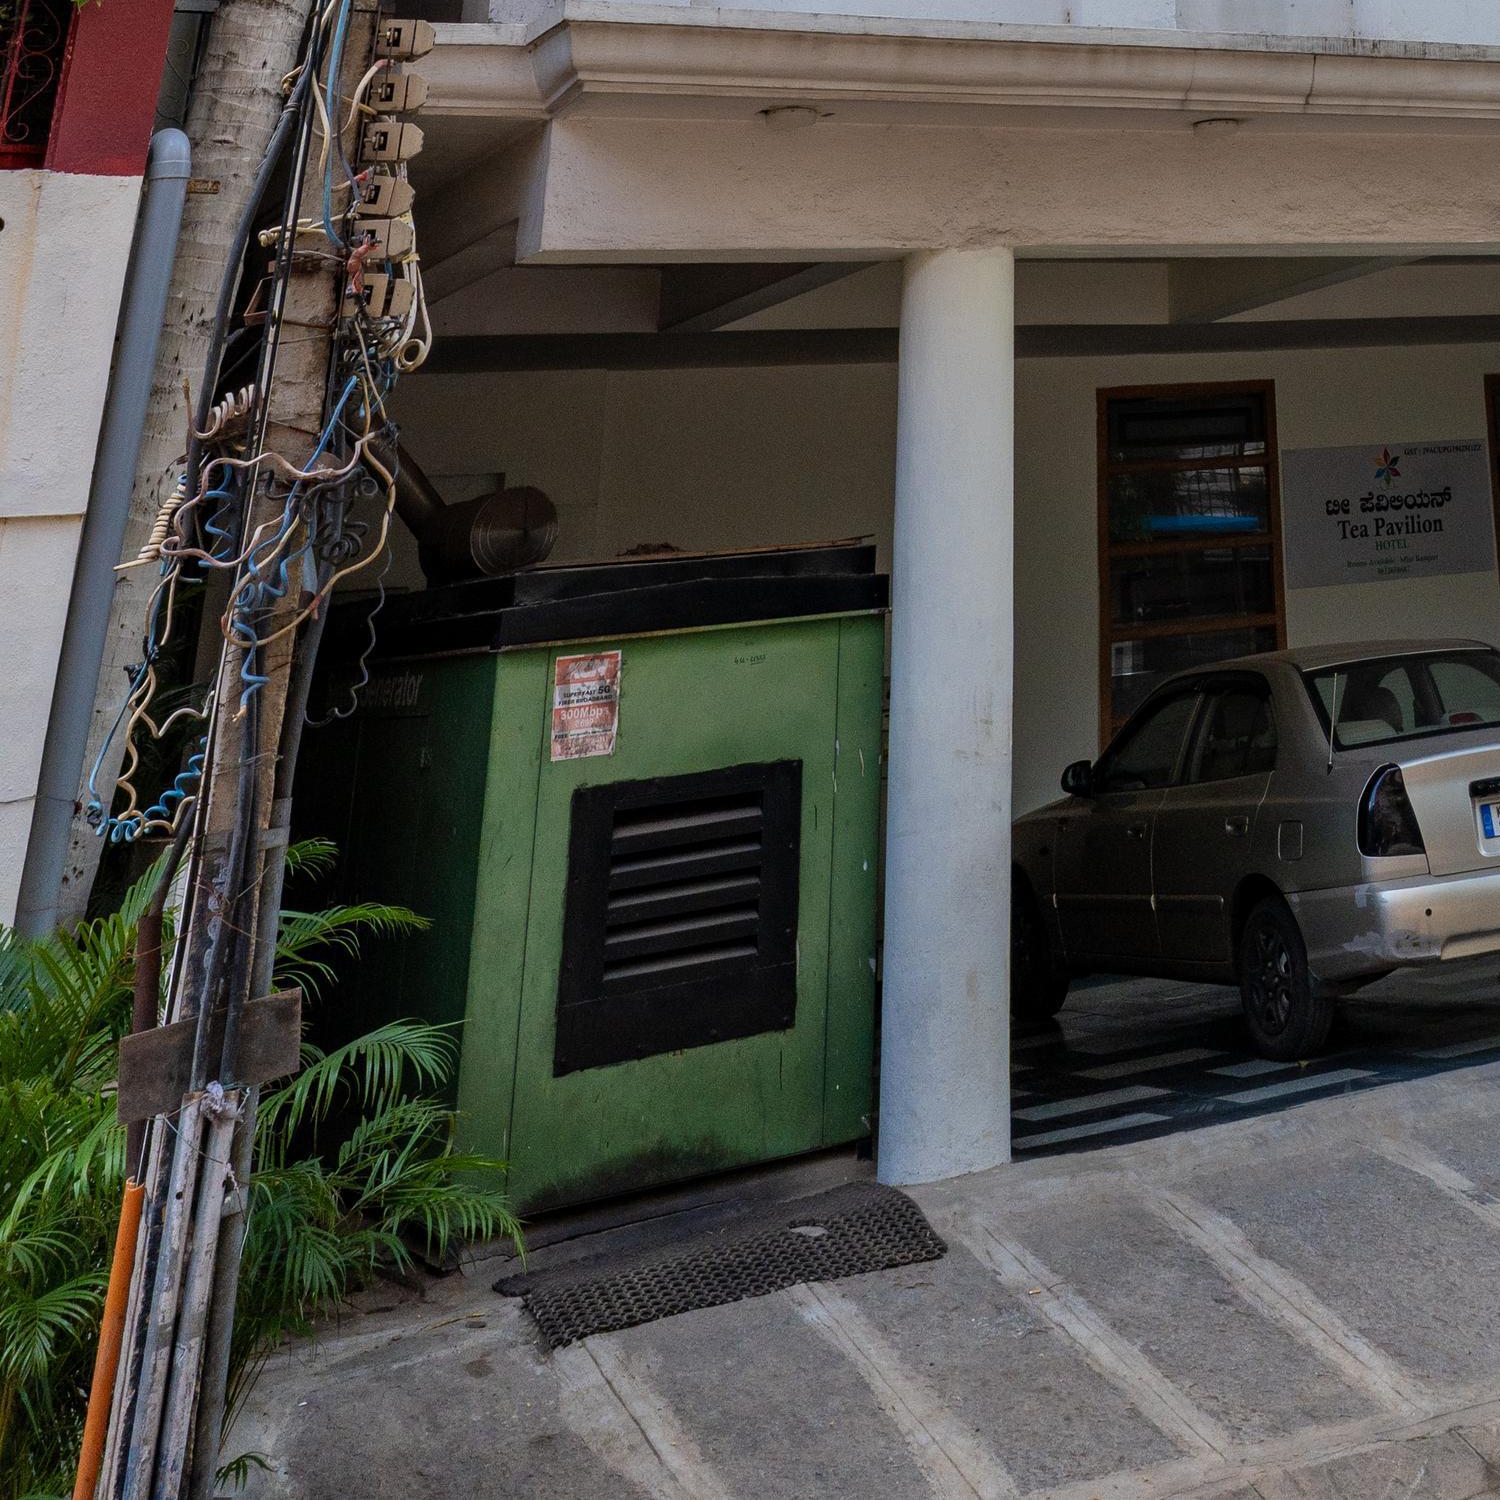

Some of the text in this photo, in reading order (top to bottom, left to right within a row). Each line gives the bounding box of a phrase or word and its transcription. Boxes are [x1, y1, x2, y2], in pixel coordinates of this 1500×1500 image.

[1338, 515, 1444, 540] Tea Pavilion
[1375, 539, 1407, 551] HOTEL
[598, 685, 611, 695] 5G
